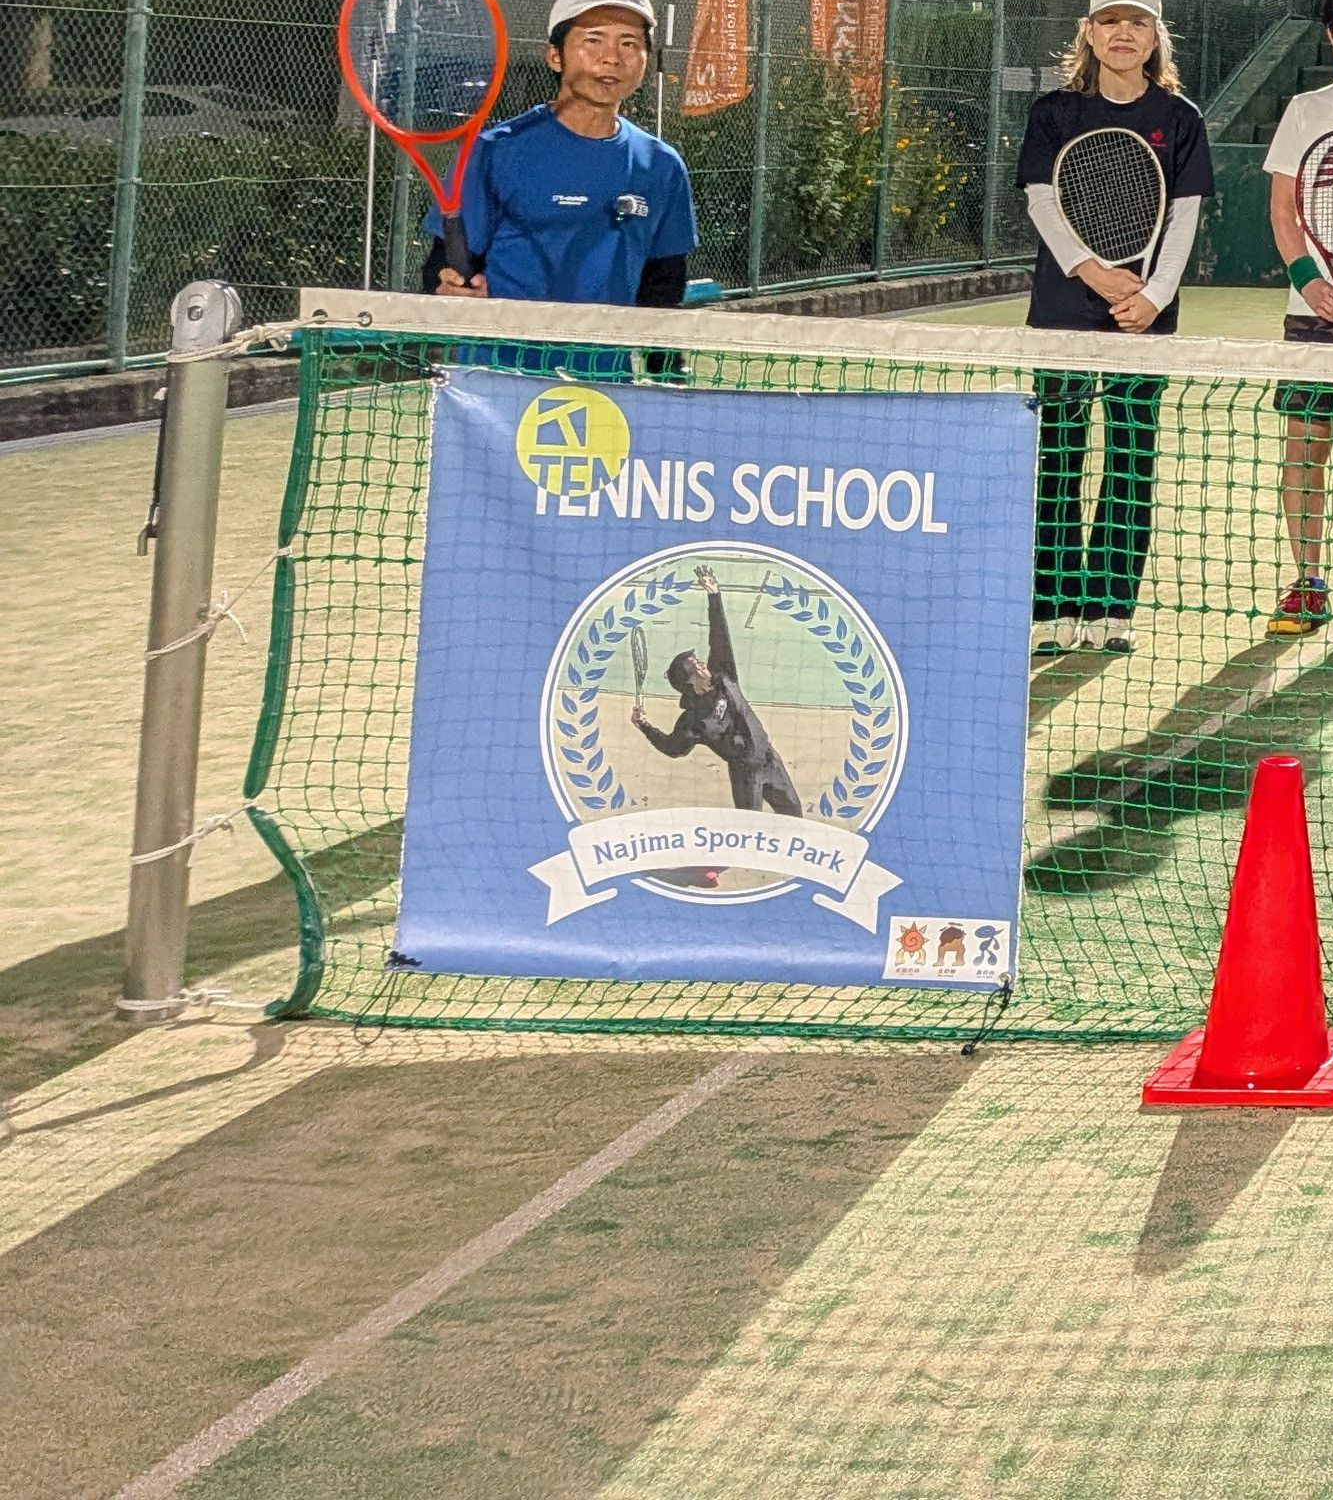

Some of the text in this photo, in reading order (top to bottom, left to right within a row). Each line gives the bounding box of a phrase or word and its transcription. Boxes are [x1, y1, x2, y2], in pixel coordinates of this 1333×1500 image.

[528, 454, 948, 535] TENNIS SCHOOL
[592, 826, 846, 874] Najima Sports Park
